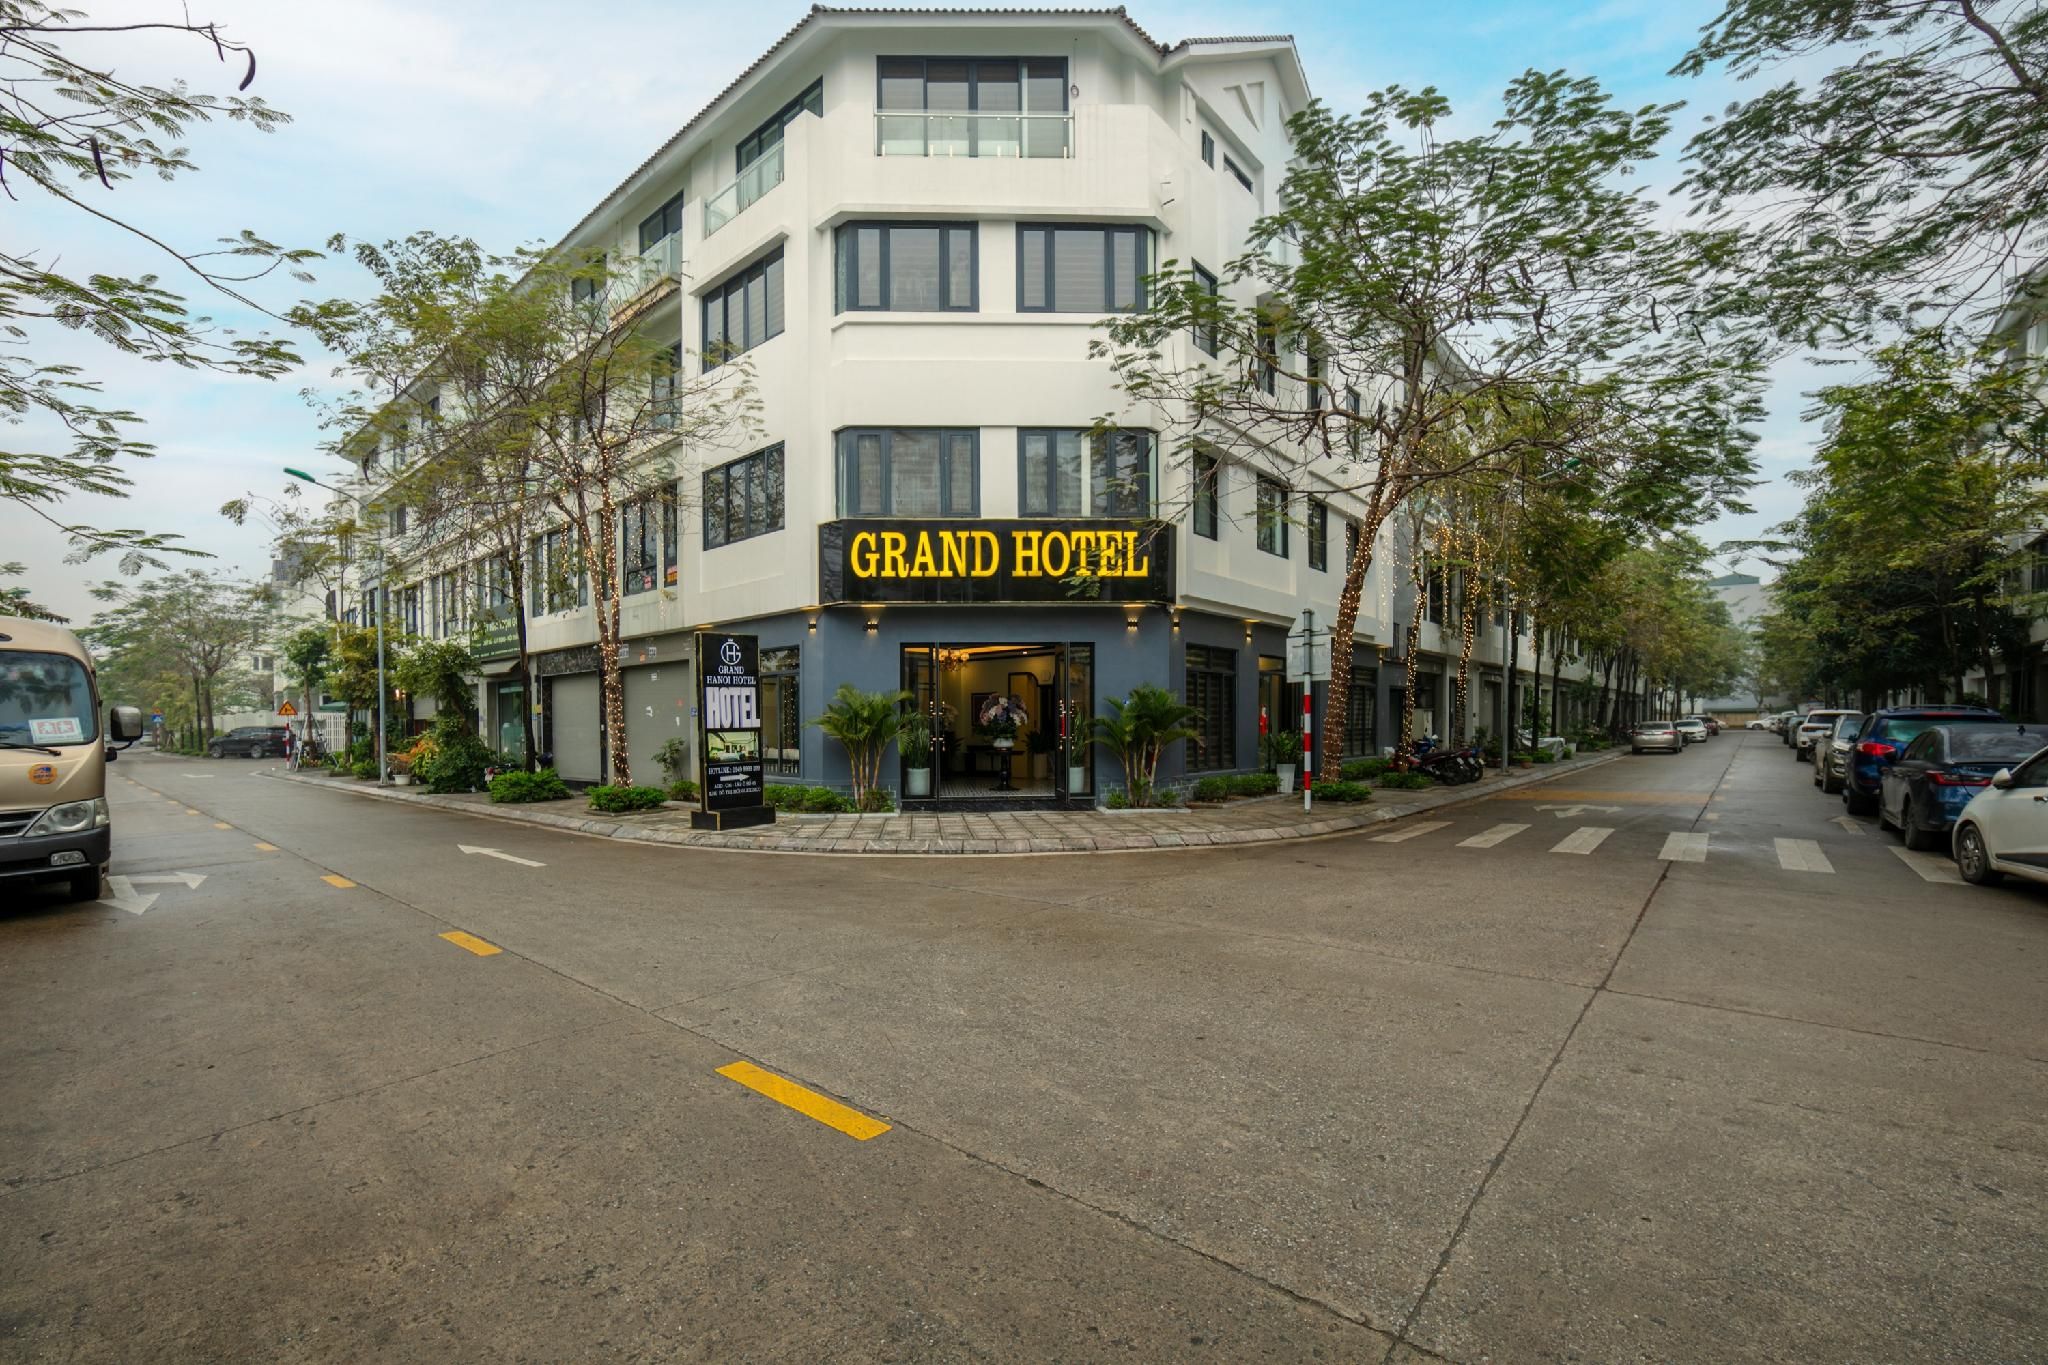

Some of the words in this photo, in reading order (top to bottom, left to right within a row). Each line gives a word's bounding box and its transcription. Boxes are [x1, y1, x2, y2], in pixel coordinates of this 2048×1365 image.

[850, 530, 1000, 578] GRAND
[1011, 530, 1149, 578] HOTEL
[706, 675, 731, 684] HANOI
[732, 676, 756, 685] HOTEL
[718, 665, 745, 674] GRAND
[706, 686, 761, 729] HOTEL
